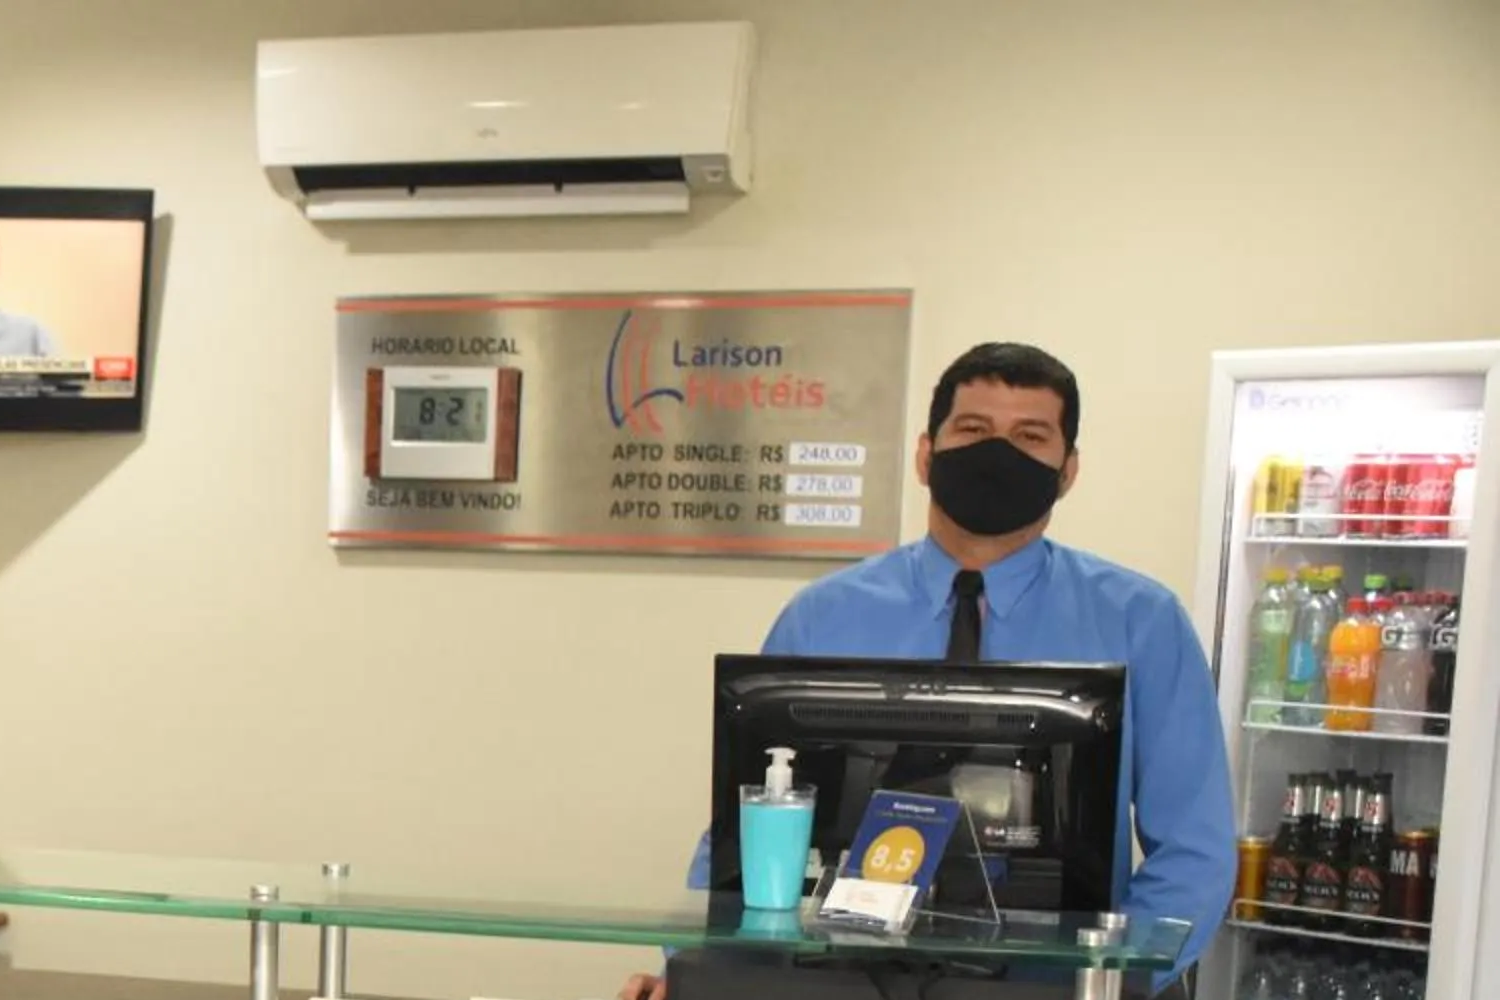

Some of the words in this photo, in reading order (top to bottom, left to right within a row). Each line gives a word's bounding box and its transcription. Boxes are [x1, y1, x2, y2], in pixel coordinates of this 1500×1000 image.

[458, 337, 520, 355] LOCAL
[673, 338, 783, 368] Larison
[687, 373, 825, 410] Hotéis
[612, 444, 663, 461] APTO
[760, 444, 784, 462] R$
[611, 472, 662, 490] APTO
[758, 473, 782, 491] R$
[365, 488, 411, 508] SEJA
[416, 489, 454, 509] BEM
[610, 499, 661, 518] APTO
[756, 503, 780, 520] R$
[870, 844, 917, 873] 8,5
